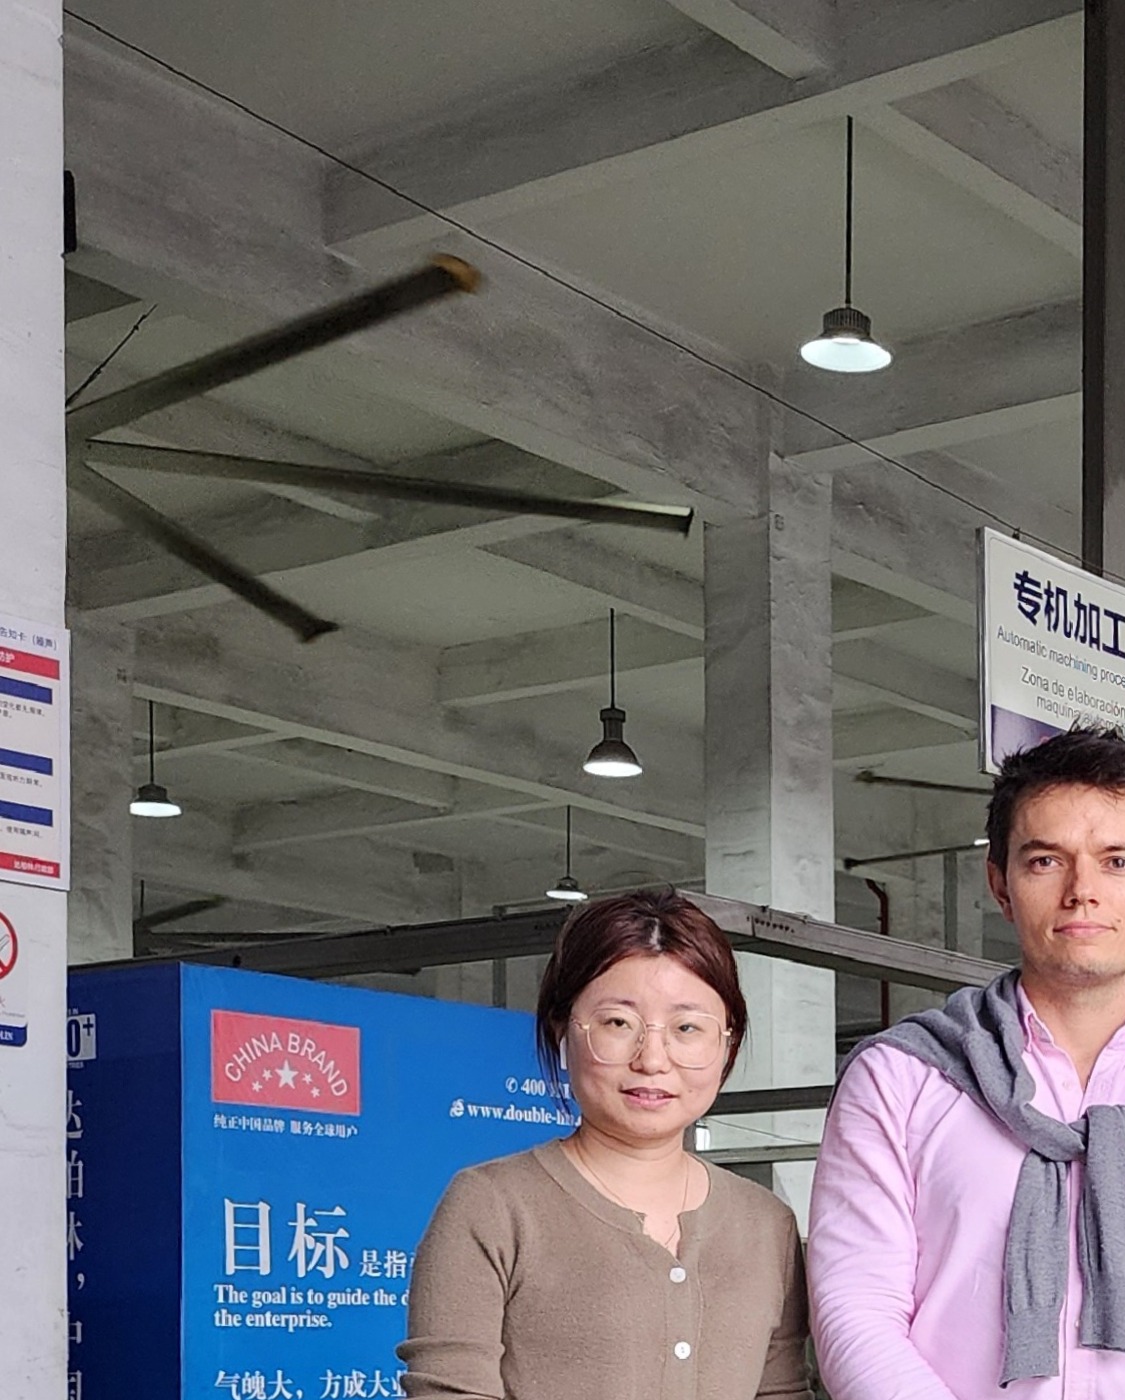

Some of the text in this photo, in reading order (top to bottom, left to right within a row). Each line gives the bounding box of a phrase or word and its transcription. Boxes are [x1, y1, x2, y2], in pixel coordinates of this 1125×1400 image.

[997, 625, 1048, 658] Automatic
[1050, 650, 1098, 680] machining
[1021, 666, 1049, 691] Zona
[1052, 679, 1065, 698] de
[224, 1032, 348, 1096] CHINA BRAND
[520, 1078, 546, 1097] 400
[223, 1198, 415, 1279] 目标 是指
[213, 1284, 248, 1304] The
[252, 1287, 287, 1308] goal
[290, 1287, 304, 1305] is
[307, 1289, 324, 1305] to
[327, 1288, 370, 1309] guide
[373, 1289, 397, 1306] the
[213, 1309, 333, 1333] the enterprise.
